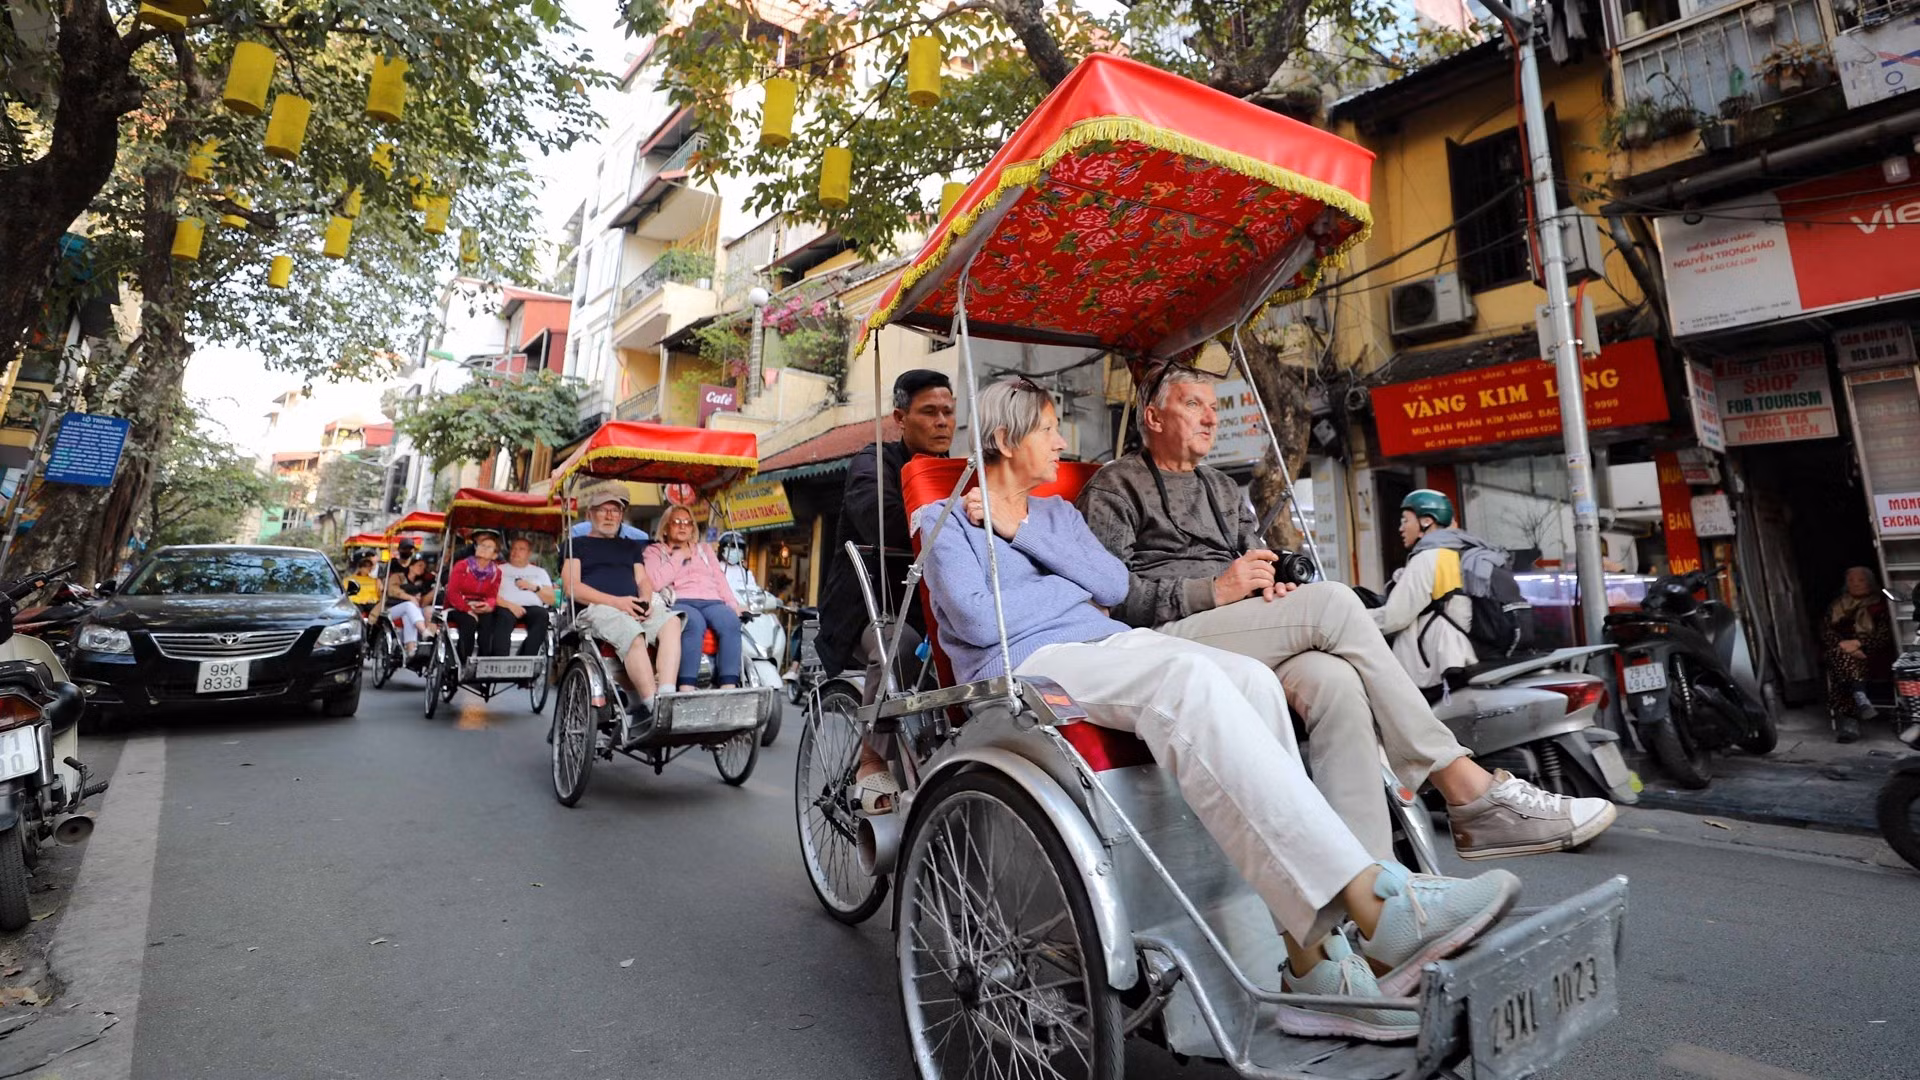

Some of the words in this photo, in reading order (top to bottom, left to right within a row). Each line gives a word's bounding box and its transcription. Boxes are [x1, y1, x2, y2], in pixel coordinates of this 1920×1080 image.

[1744, 373, 1799, 395] SHOP
[706, 391, 732, 405] Café
[1402, 394, 1467, 419] VÀNG
[1478, 384, 1529, 408] KIM
[1543, 369, 1619, 398] LNG
[1727, 398, 1753, 414] FOR
[1758, 391, 1823, 411] TOURISM
[68, 420, 92, 428] ELECTRIC
[1412, 426, 1431, 435] MUA
[1507, 411, 1533, 422] VÀNG
[210, 663, 239, 677] 99K
[203, 676, 242, 690] 8338
